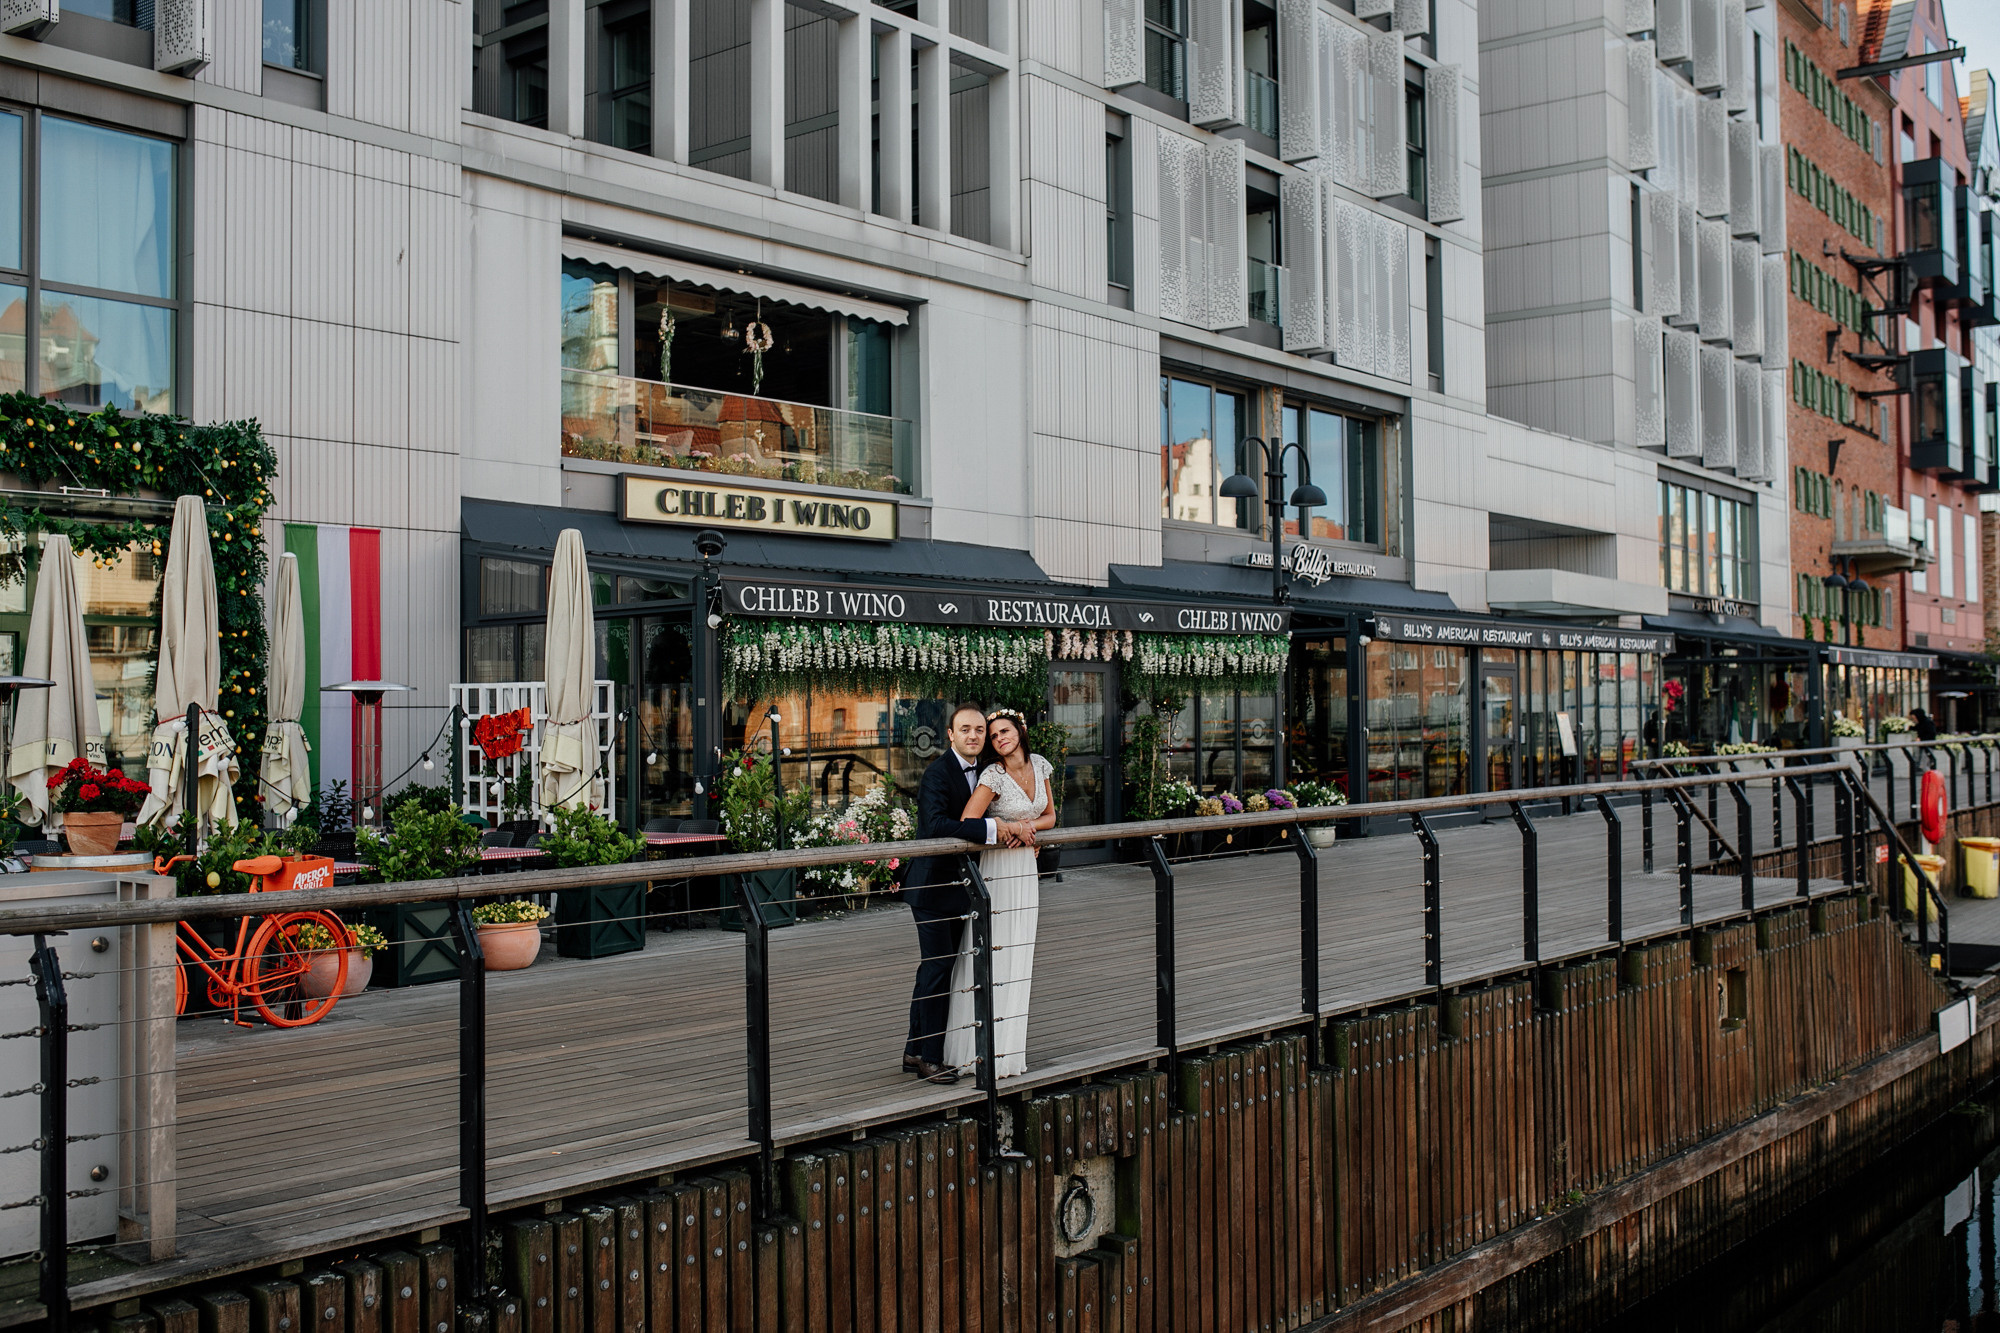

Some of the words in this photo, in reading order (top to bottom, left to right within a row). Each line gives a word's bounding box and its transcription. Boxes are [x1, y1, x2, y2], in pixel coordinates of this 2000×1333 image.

[658, 487, 767, 521] CHLEB
[774, 498, 786, 523] I
[793, 500, 872, 531] WINO
[1251, 553, 1292, 568] AMERAN
[1294, 543, 1332, 586] Billy's
[1333, 562, 1377, 577] RESTAURANTS
[739, 586, 820, 613] CHLEB
[826, 591, 834, 615] I
[839, 591, 906, 618] WINO
[987, 599, 1112, 629] RESTAURACJA
[1177, 609, 1228, 631] CHLEB
[1231, 612, 1237, 631] I
[1240, 612, 1282, 632] WINO
[1403, 623, 1433, 639] BILLY'S
[1437, 626, 1480, 642] AMERICAN
[1483, 629, 1533, 644] RESTAURANT
[1559, 633, 1582, 647] BILLY'S
[1584, 635, 1617, 649] AMERICAN
[1620, 638, 1658, 650] RESTAURANT
[293, 866, 330, 890] APEROL
